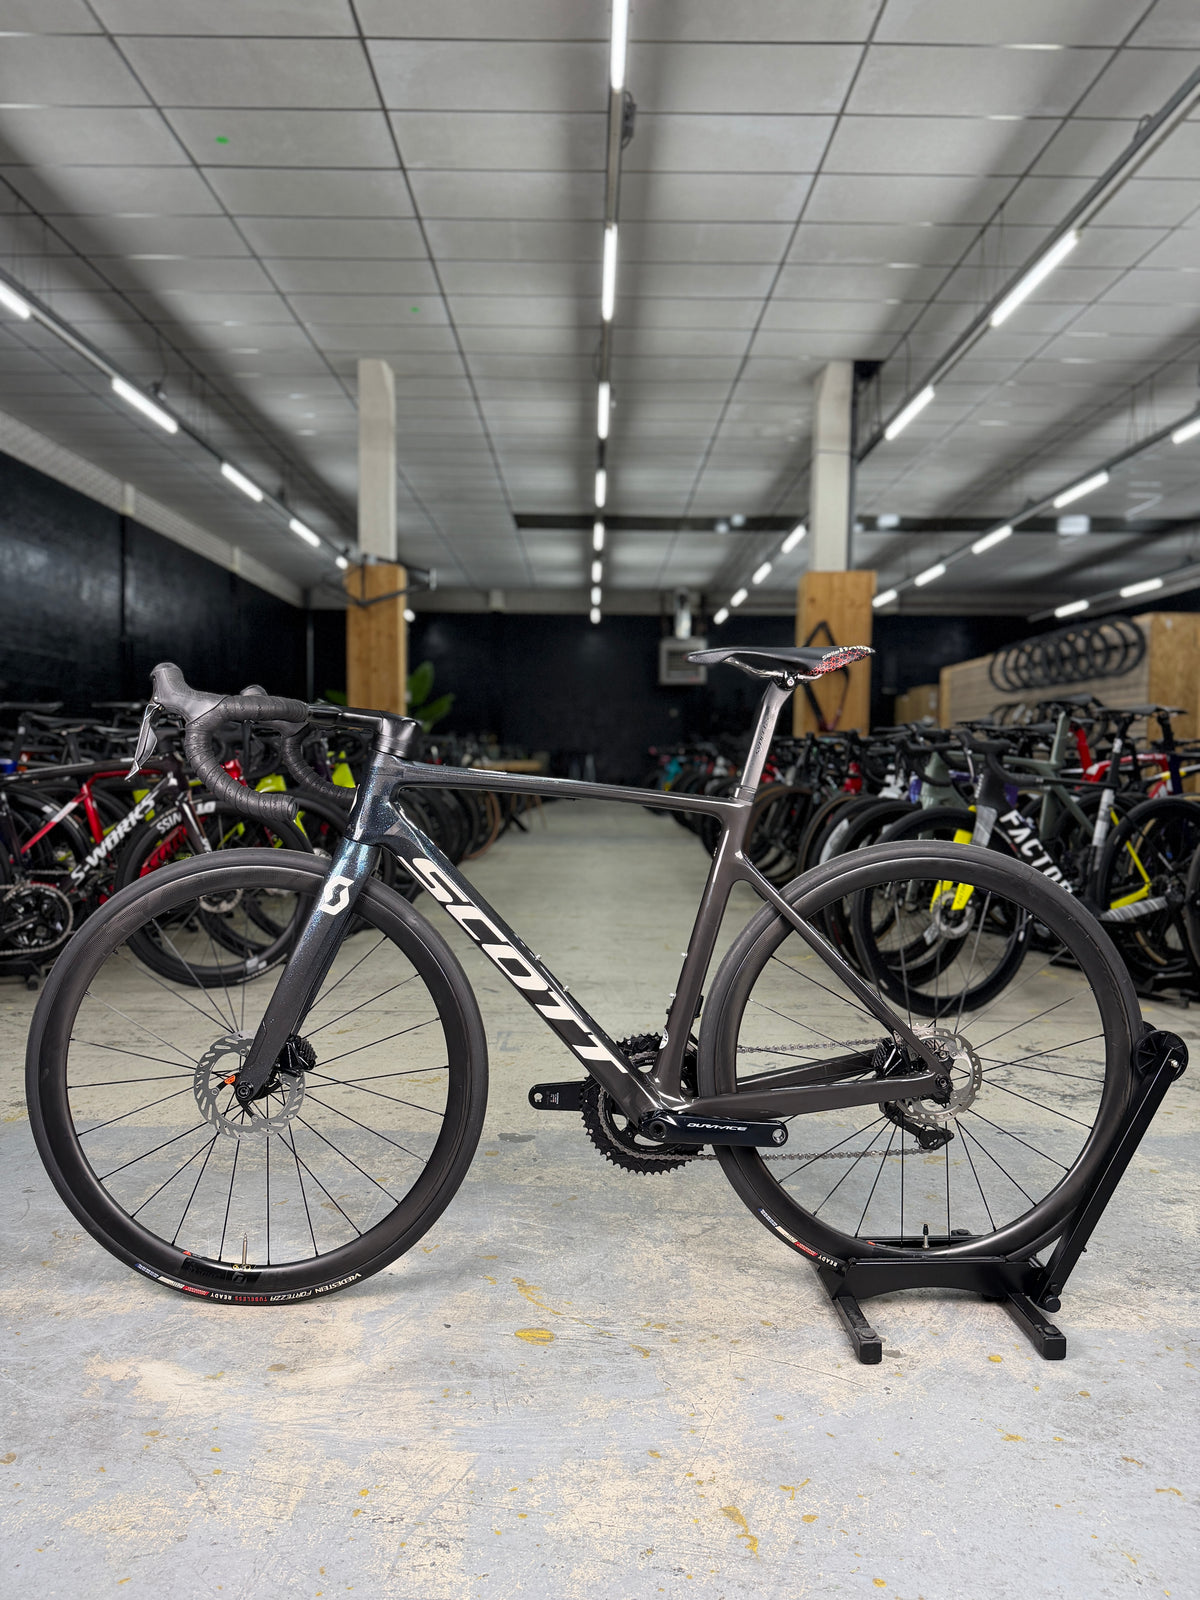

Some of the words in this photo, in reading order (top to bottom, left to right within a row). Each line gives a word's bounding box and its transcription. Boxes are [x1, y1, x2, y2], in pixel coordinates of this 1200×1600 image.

[70, 789, 160, 886] S-WORKS
[155, 811, 183, 835] WISS
[400, 856, 630, 1074] SCOTT
[210, 1292, 232, 1301] READY
